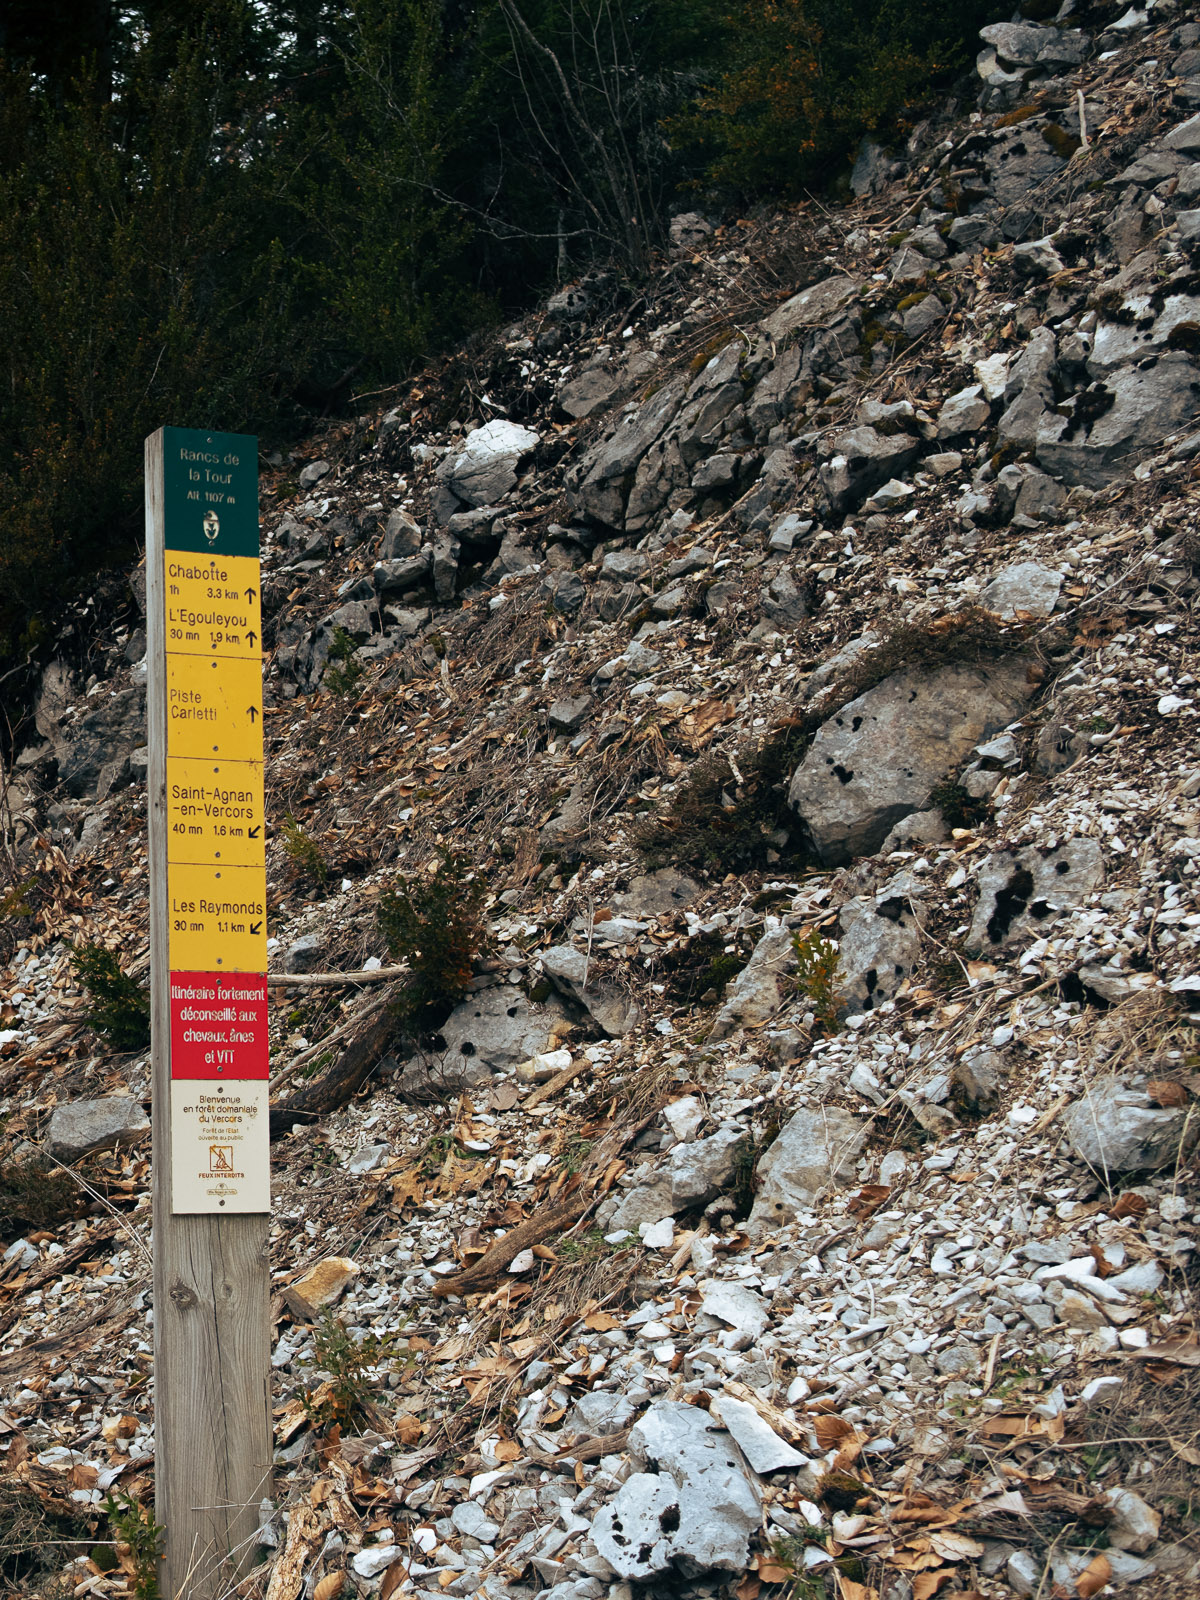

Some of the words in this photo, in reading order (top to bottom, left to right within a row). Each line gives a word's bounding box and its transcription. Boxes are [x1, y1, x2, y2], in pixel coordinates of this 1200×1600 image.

[180, 448, 219, 463] Rancs
[224, 453, 239, 465] de
[189, 468, 200, 481] la
[205, 469, 232, 484] Tour
[205, 491, 224, 502] 1107
[227, 496, 235, 504] m
[168, 564, 228, 581] Chabotte
[170, 585, 179, 595] 1h
[207, 588, 222, 598] 3.3
[225, 590, 238, 600] km
[169, 608, 247, 628] L'Egouleyou
[170, 629, 182, 640] 30
[186, 632, 199, 640] mn
[210, 632, 222, 642] 1.9
[226, 633, 239, 644] km
[170, 689, 201, 704] Piste
[171, 705, 217, 721] Carletti
[172, 785, 253, 804] Saint-Agnan
[173, 804, 253, 819] -en-Vercors
[173, 824, 186, 834] 40
[189, 826, 202, 835] mn
[213, 825, 226, 836] 1.6
[230, 826, 243, 836] km
[173, 899, 195, 912] Les
[200, 900, 263, 916] Raymonds
[174, 920, 186, 931] 30
[190, 922, 204, 931] mn
[218, 922, 228, 932] 1.1
[231, 922, 245, 932] km
[172, 985, 215, 1000] Itinéraire
[218, 986, 265, 1000] fortement
[180, 1006, 236, 1021] déconseillé
[239, 1011, 257, 1021] aux
[230, 1028, 254, 1042] ânes
[205, 1050, 215, 1063] et
[217, 1050, 234, 1063] VTT
[195, 1105, 215, 1113] forêt
